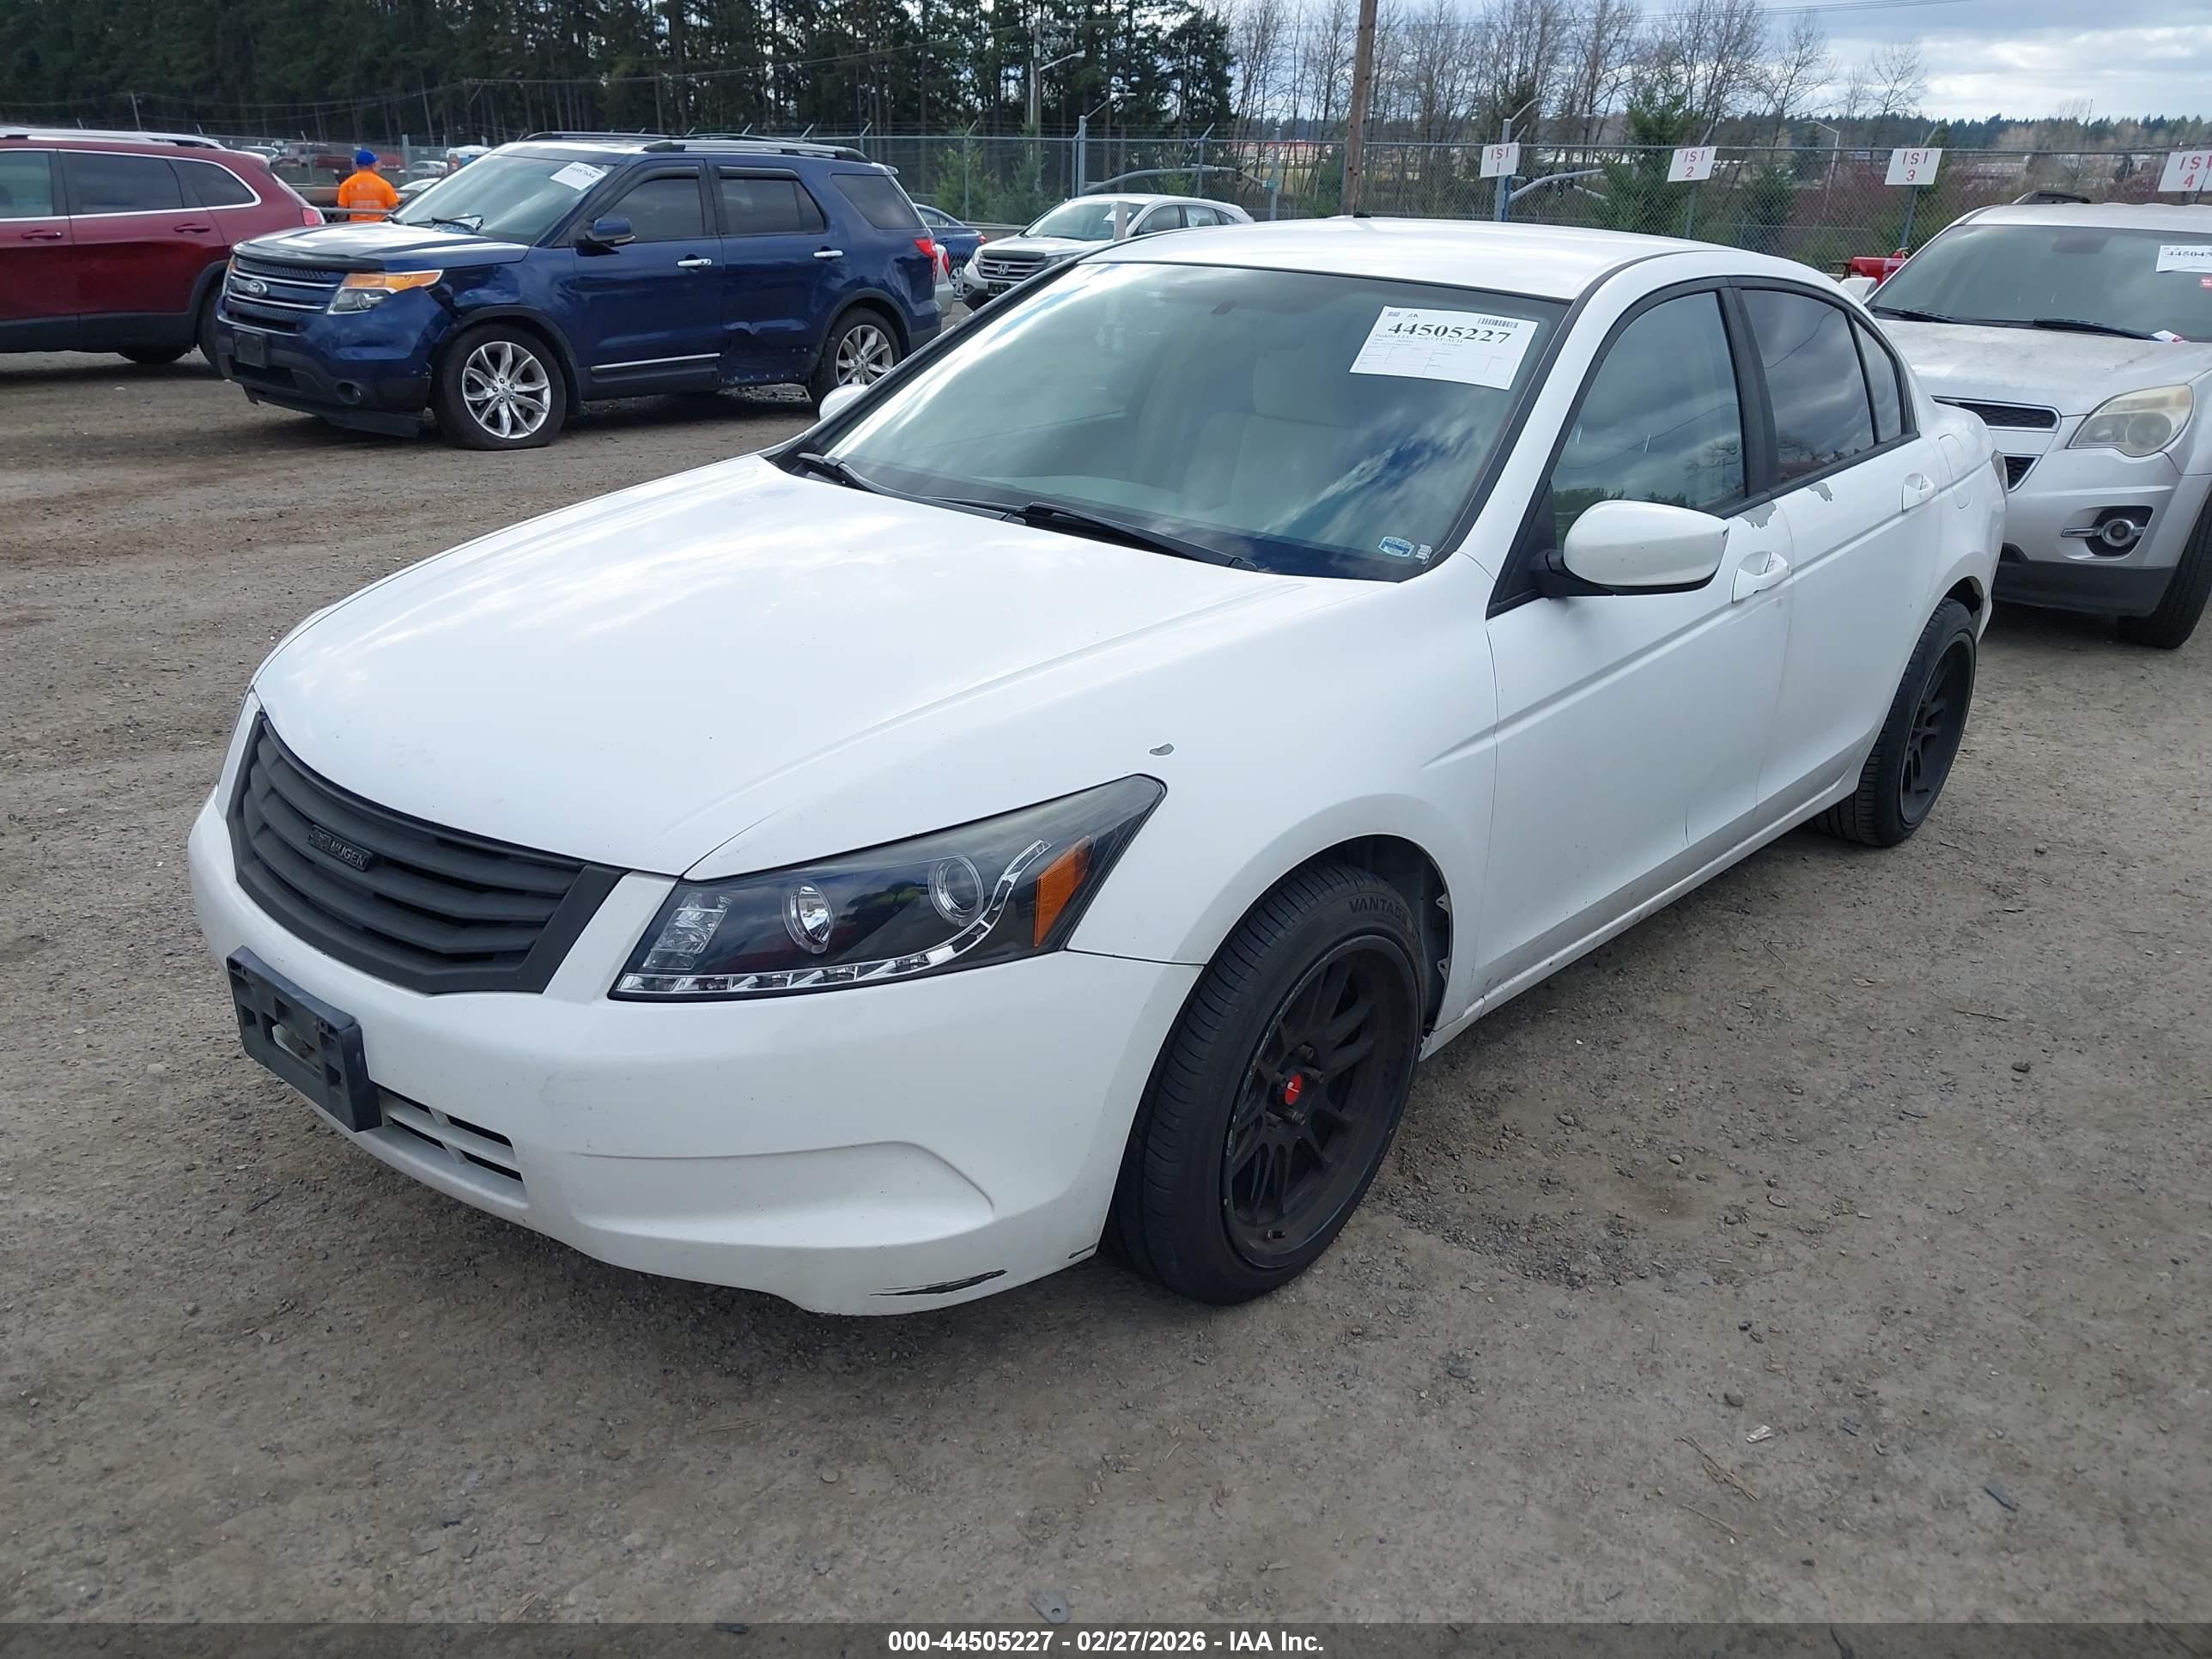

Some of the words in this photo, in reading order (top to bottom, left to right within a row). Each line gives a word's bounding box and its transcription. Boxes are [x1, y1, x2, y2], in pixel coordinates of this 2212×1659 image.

[1685, 166, 1694, 178] 2
[1905, 169, 1917, 182] 3
[2183, 173, 2195, 188] 4
[1387, 322, 1512, 344] 44505227
[329, 840, 367, 866] MUGEN
